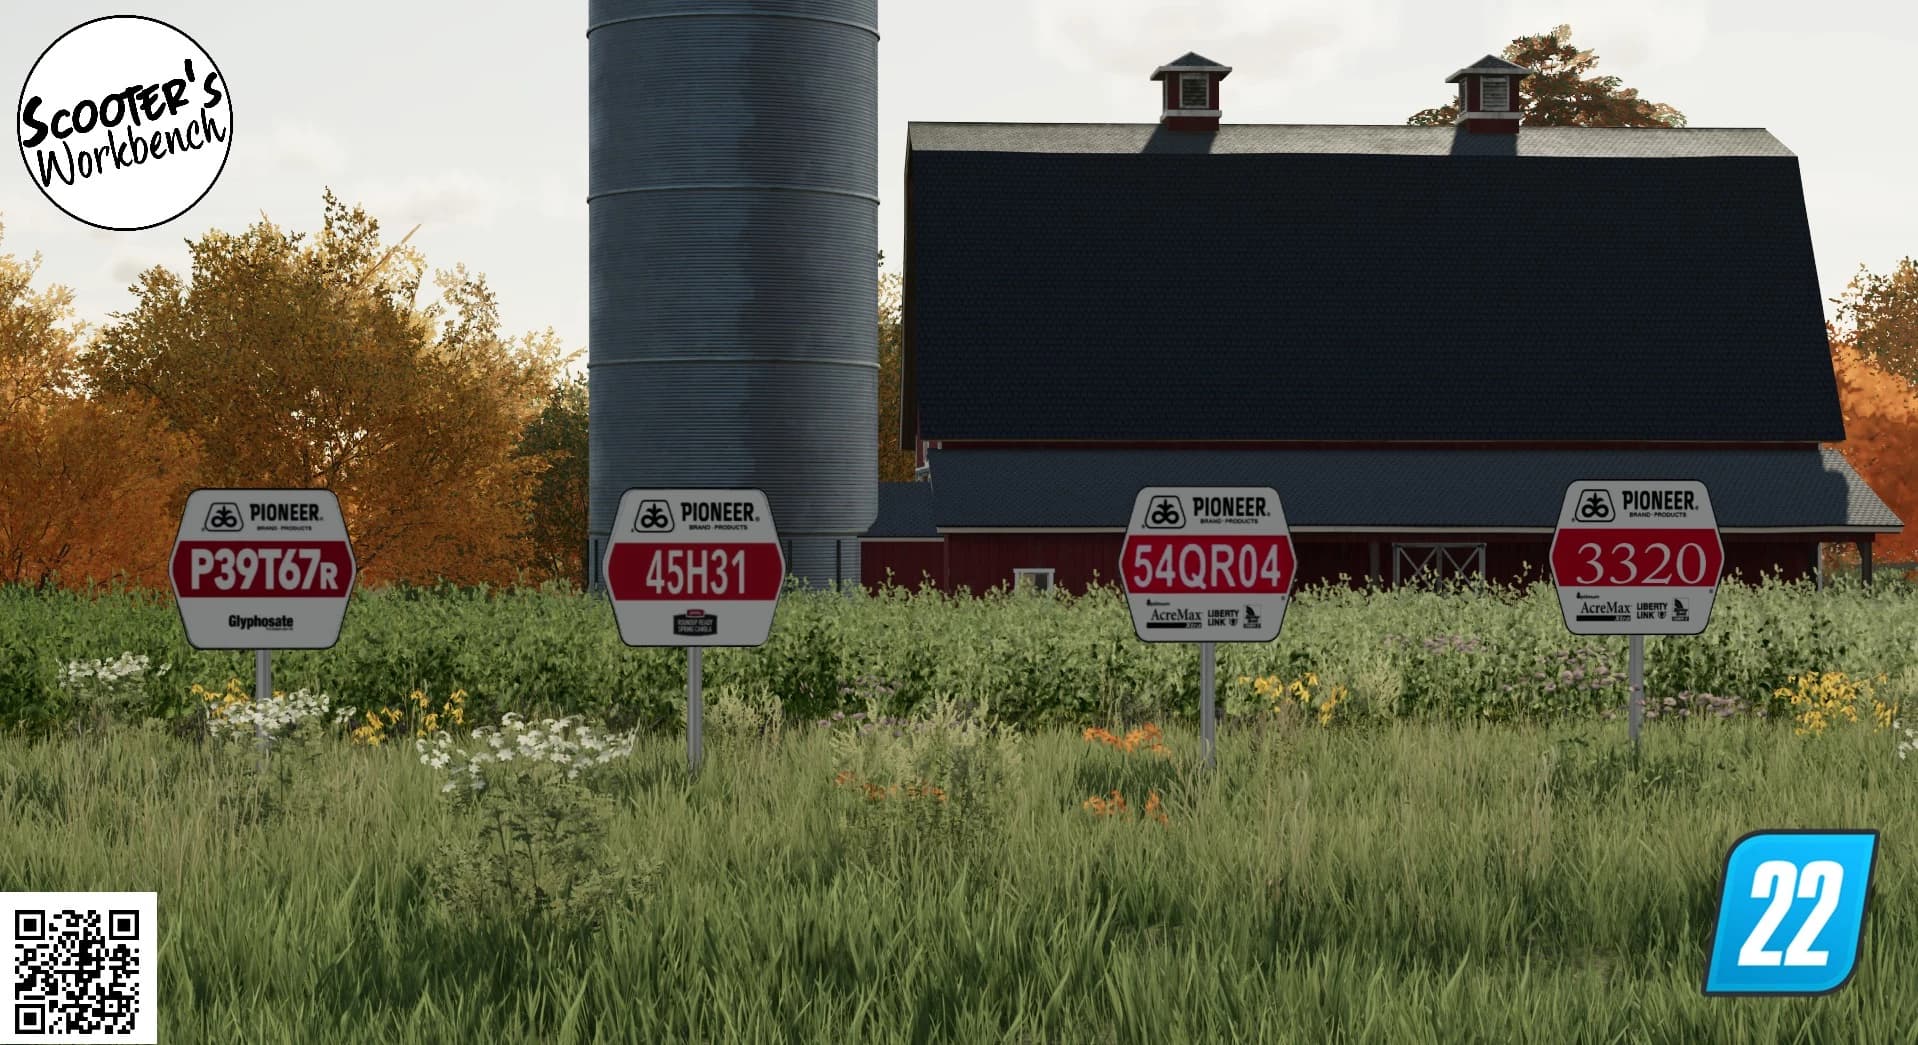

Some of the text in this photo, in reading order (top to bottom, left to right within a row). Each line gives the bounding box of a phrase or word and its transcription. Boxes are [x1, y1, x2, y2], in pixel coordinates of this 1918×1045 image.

[1193, 497, 1266, 517] PIONEER
[1622, 490, 1694, 510] PIONEER
[249, 503, 320, 521] PIONEER
[680, 502, 754, 522] PIONEER
[191, 548, 338, 590] P39T67R
[646, 549, 745, 594] 45H31
[1133, 543, 1280, 589] 54QR04
[1575, 542, 1706, 585] 3320
[1151, 608, 1202, 621] AcreMax
[1207, 610, 1239, 618] LIBERTY
[1581, 601, 1631, 614] AcreMax
[1636, 602, 1667, 610] LIBERTY
[1636, 611, 1654, 619] LINK
[228, 614, 294, 630] Glyphosate
